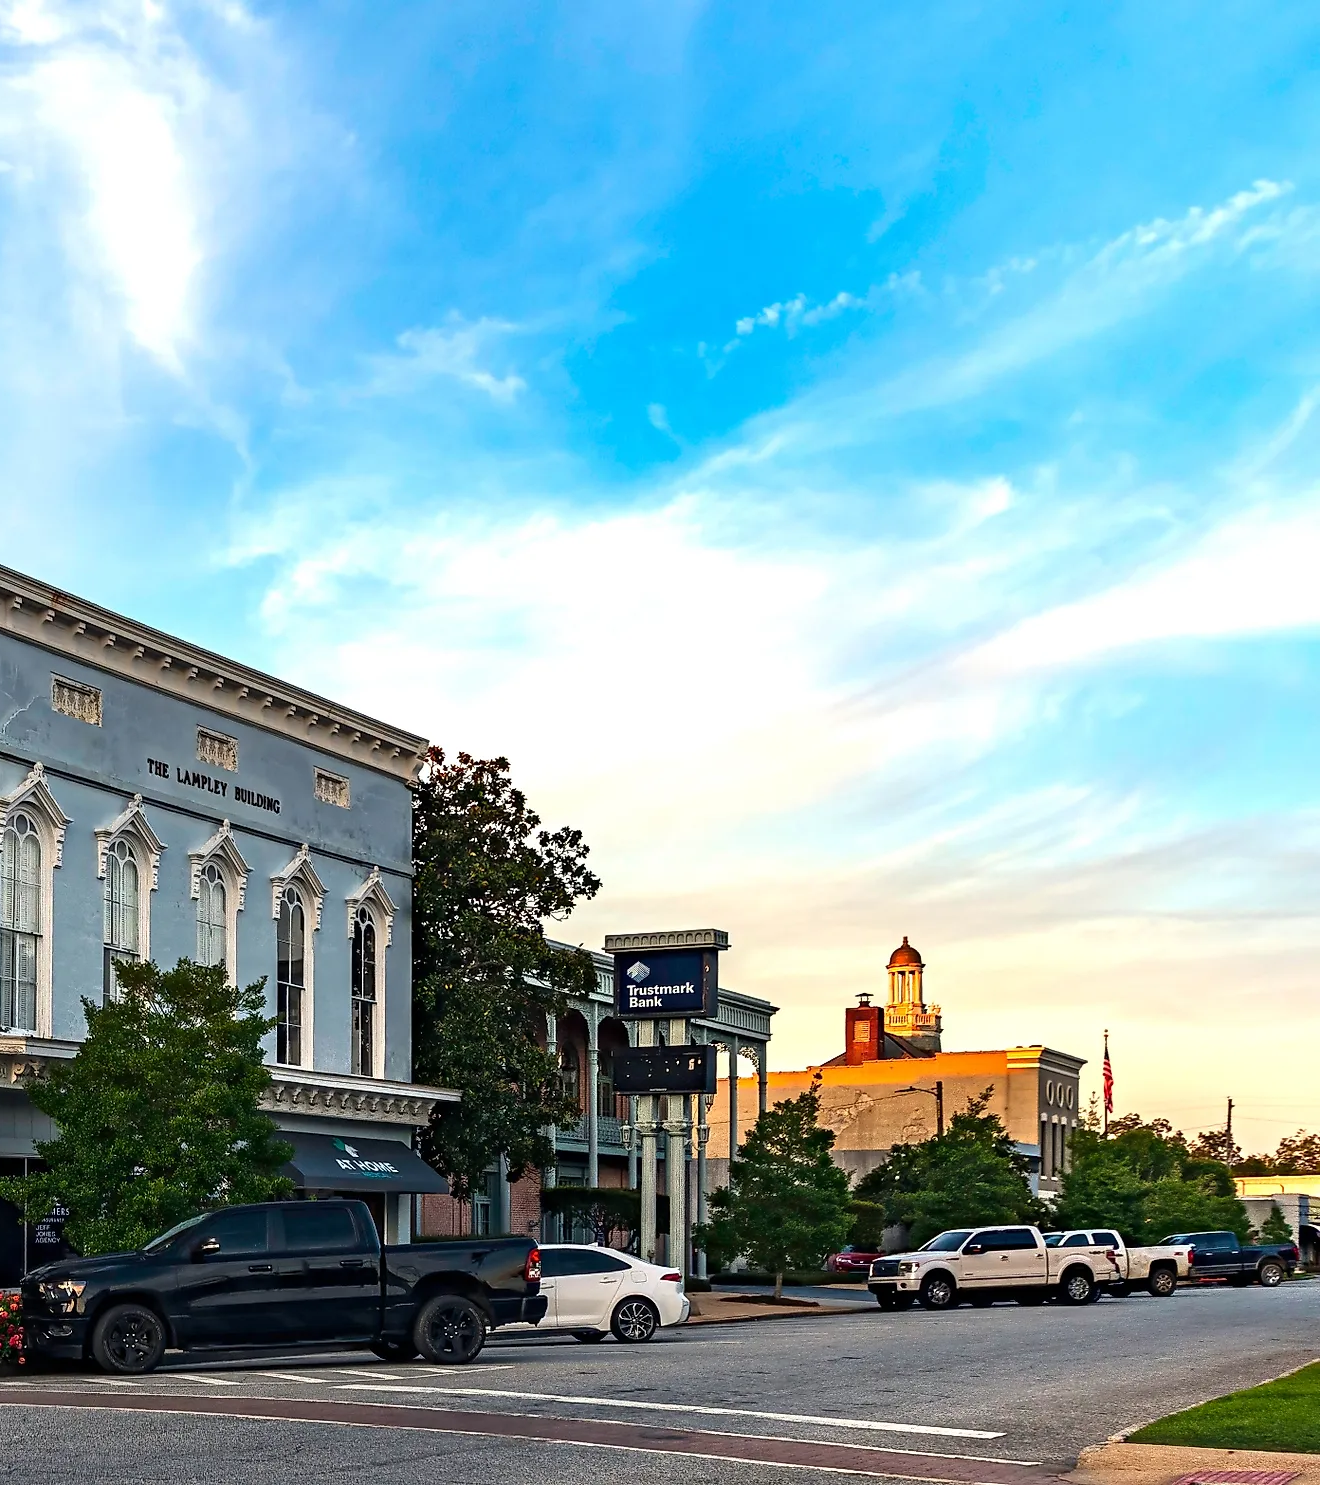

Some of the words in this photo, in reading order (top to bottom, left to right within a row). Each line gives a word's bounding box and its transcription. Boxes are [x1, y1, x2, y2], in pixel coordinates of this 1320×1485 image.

[147, 757, 169, 779] THE
[177, 767, 228, 797] LAMPLEY
[234, 786, 281, 815] BUILDING
[626, 982, 695, 996] Trustmark
[629, 996, 663, 1008] Bank
[335, 1158, 356, 1170] AT
[353, 1160, 399, 1172] HOME
